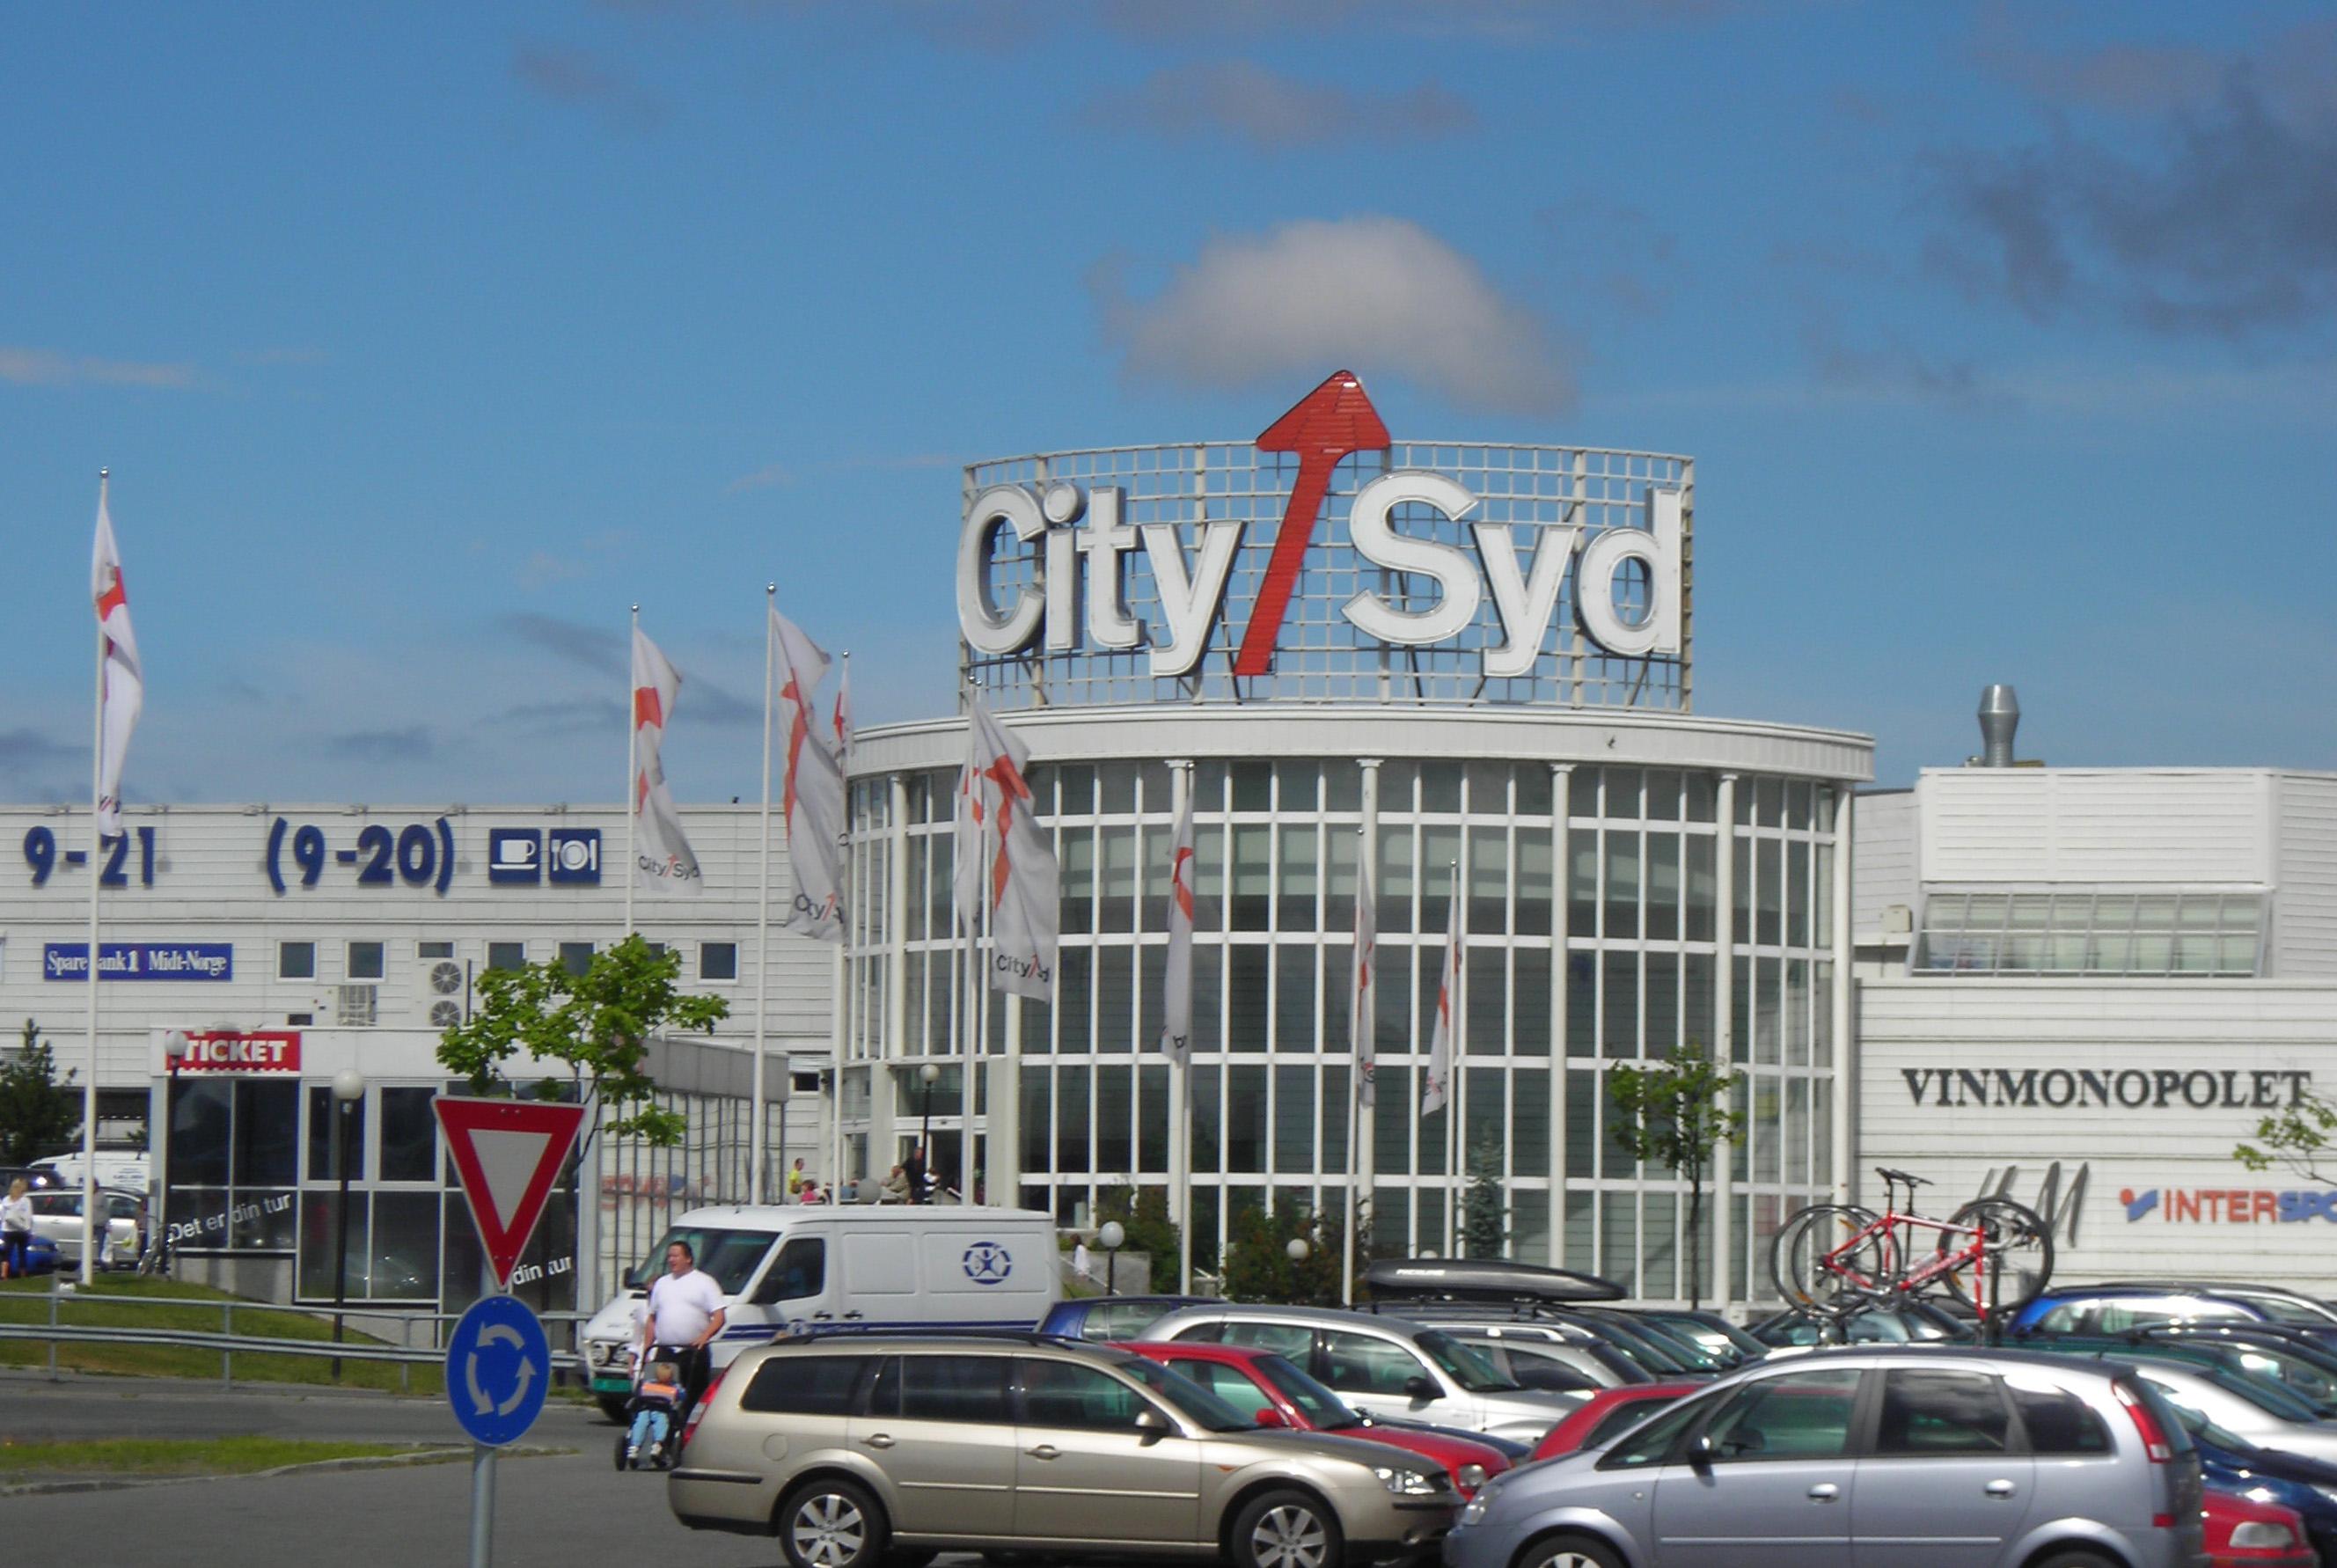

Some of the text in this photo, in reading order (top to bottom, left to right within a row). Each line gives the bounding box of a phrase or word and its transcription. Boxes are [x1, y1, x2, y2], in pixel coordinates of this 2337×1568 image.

[956, 470, 1682, 677] City Syd
[267, 817, 454, 895] (9-20)
[149, 950, 226, 976] Midt-Norge
[185, 1039, 288, 1062] TICKET
[1901, 1068, 2311, 1109] VINMONOPOLET
[168, 1193, 291, 1242] Det er din tur
[513, 1264, 543, 1285] din
